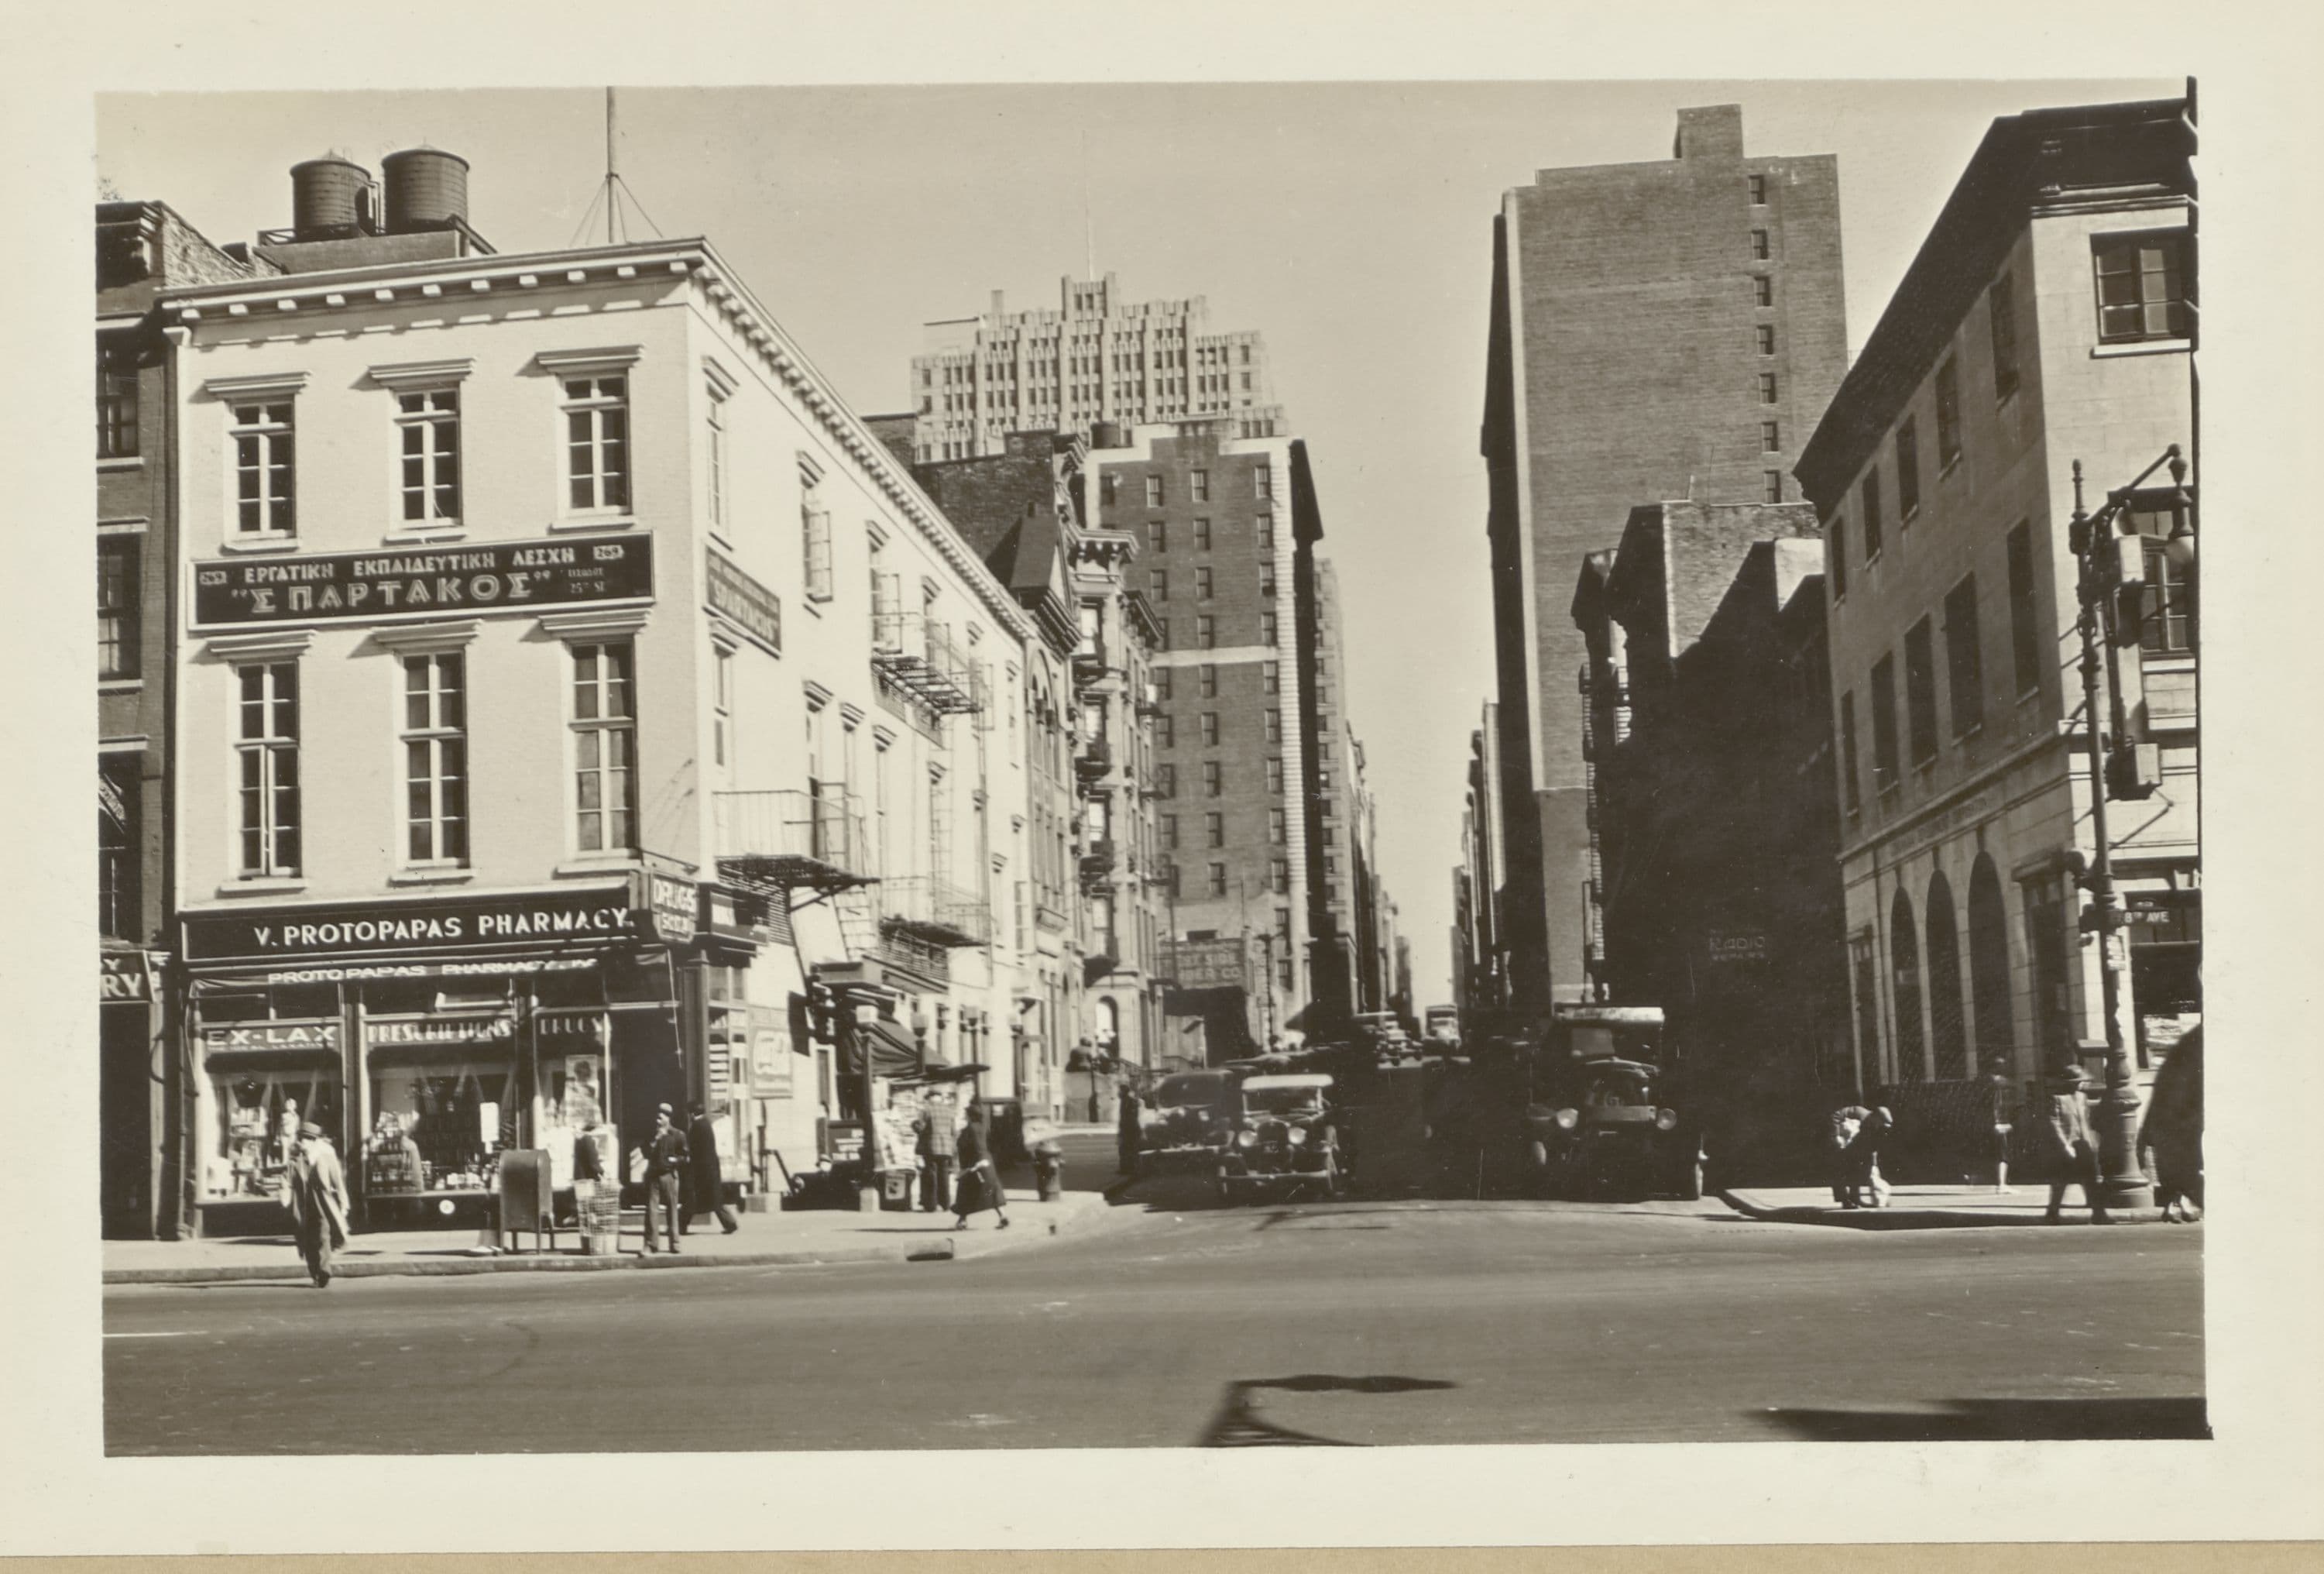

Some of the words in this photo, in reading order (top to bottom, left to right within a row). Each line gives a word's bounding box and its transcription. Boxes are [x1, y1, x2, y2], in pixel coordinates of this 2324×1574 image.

[245, 563, 334, 583] ΕΡΓΑΤΙΚΗ
[354, 552, 495, 576] ΕΚΠΑΙΔΕΥΤΙΚΗ
[513, 547, 575, 566] ΛΕΣΧΗ
[2146, 911, 2170, 923] AVE
[254, 926, 278, 947] V.
[284, 916, 462, 946] PROTOPAPAS
[206, 1026, 338, 1046] EX-LAX
